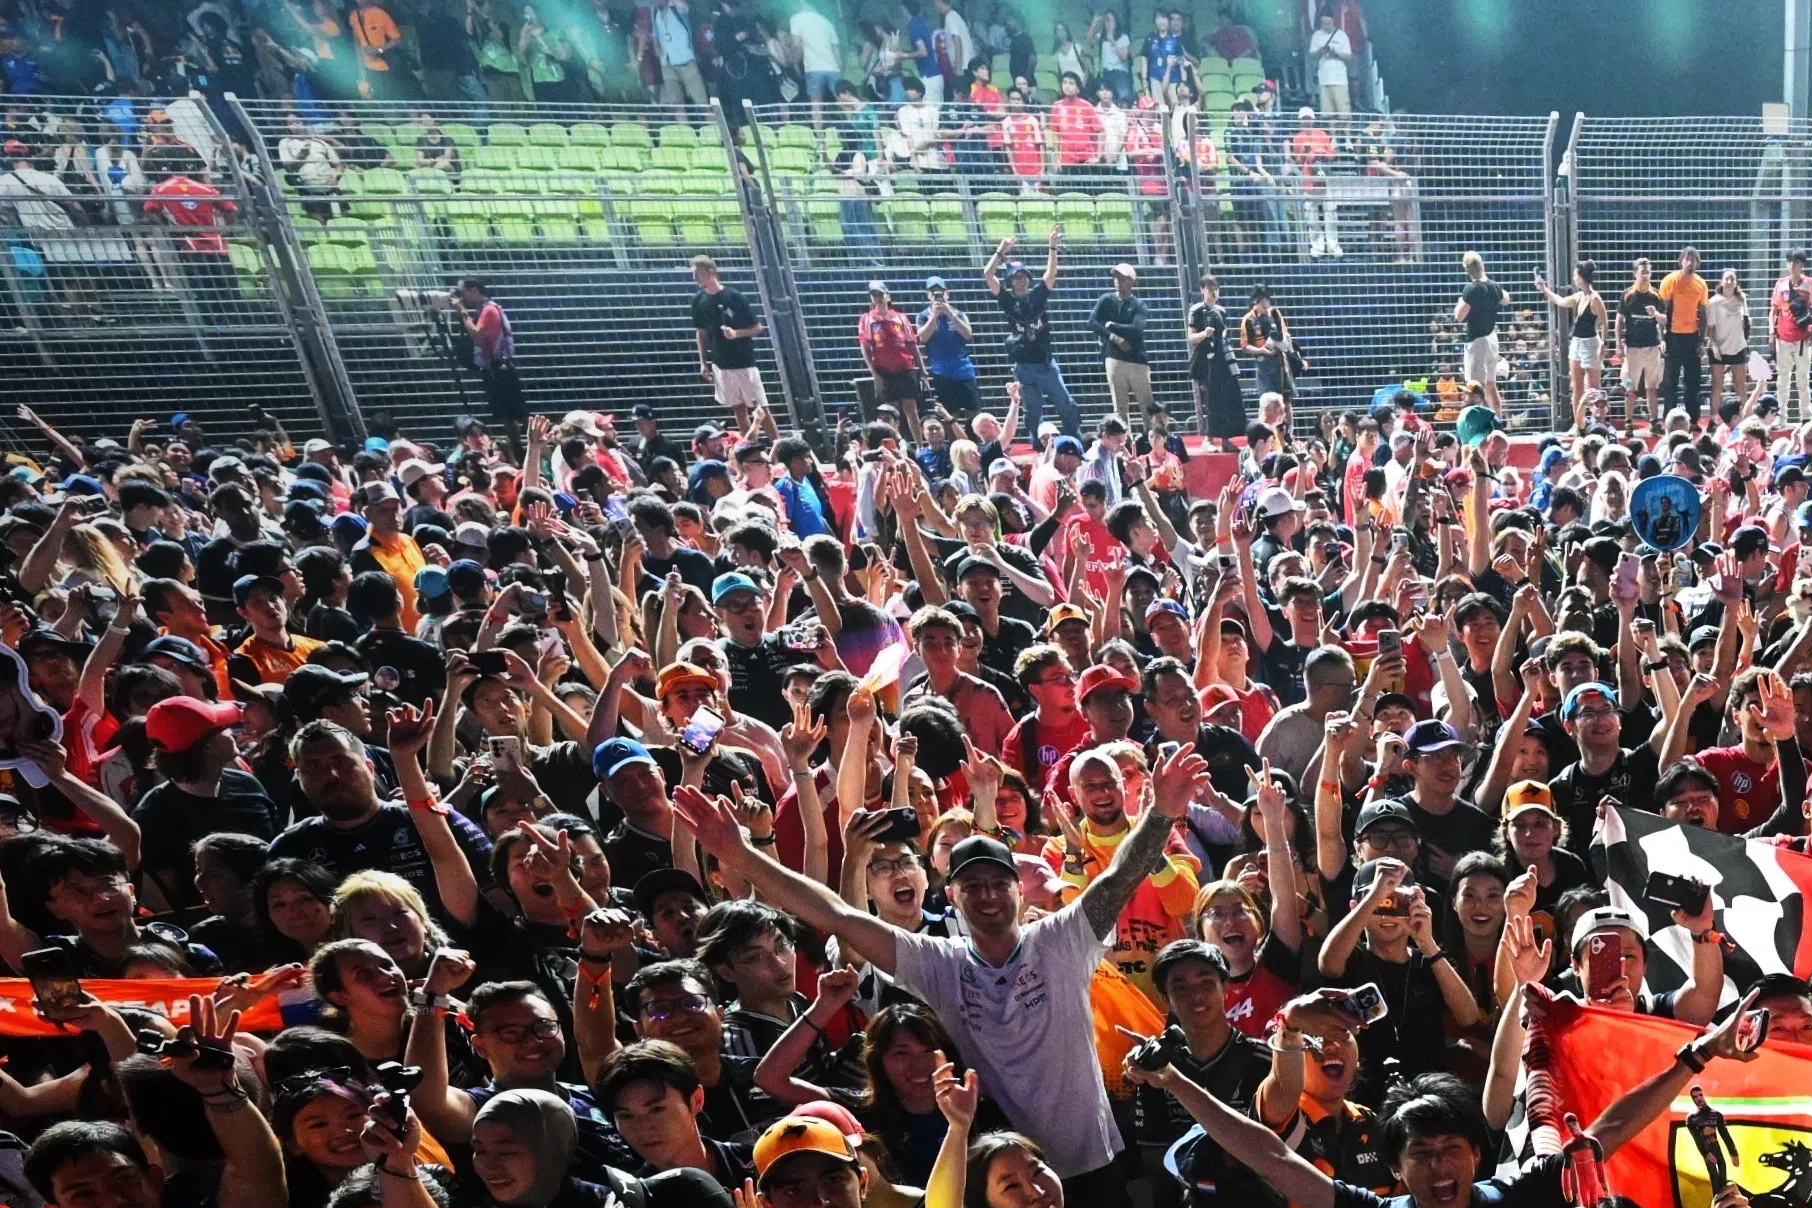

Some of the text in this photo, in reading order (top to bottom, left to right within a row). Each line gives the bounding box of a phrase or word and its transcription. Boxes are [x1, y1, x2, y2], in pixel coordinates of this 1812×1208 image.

[1040, 745, 1058, 766] hp
[1733, 771, 1749, 793] hp
[1024, 993, 1047, 1010] HPE
[1225, 997, 1254, 1022] 44
